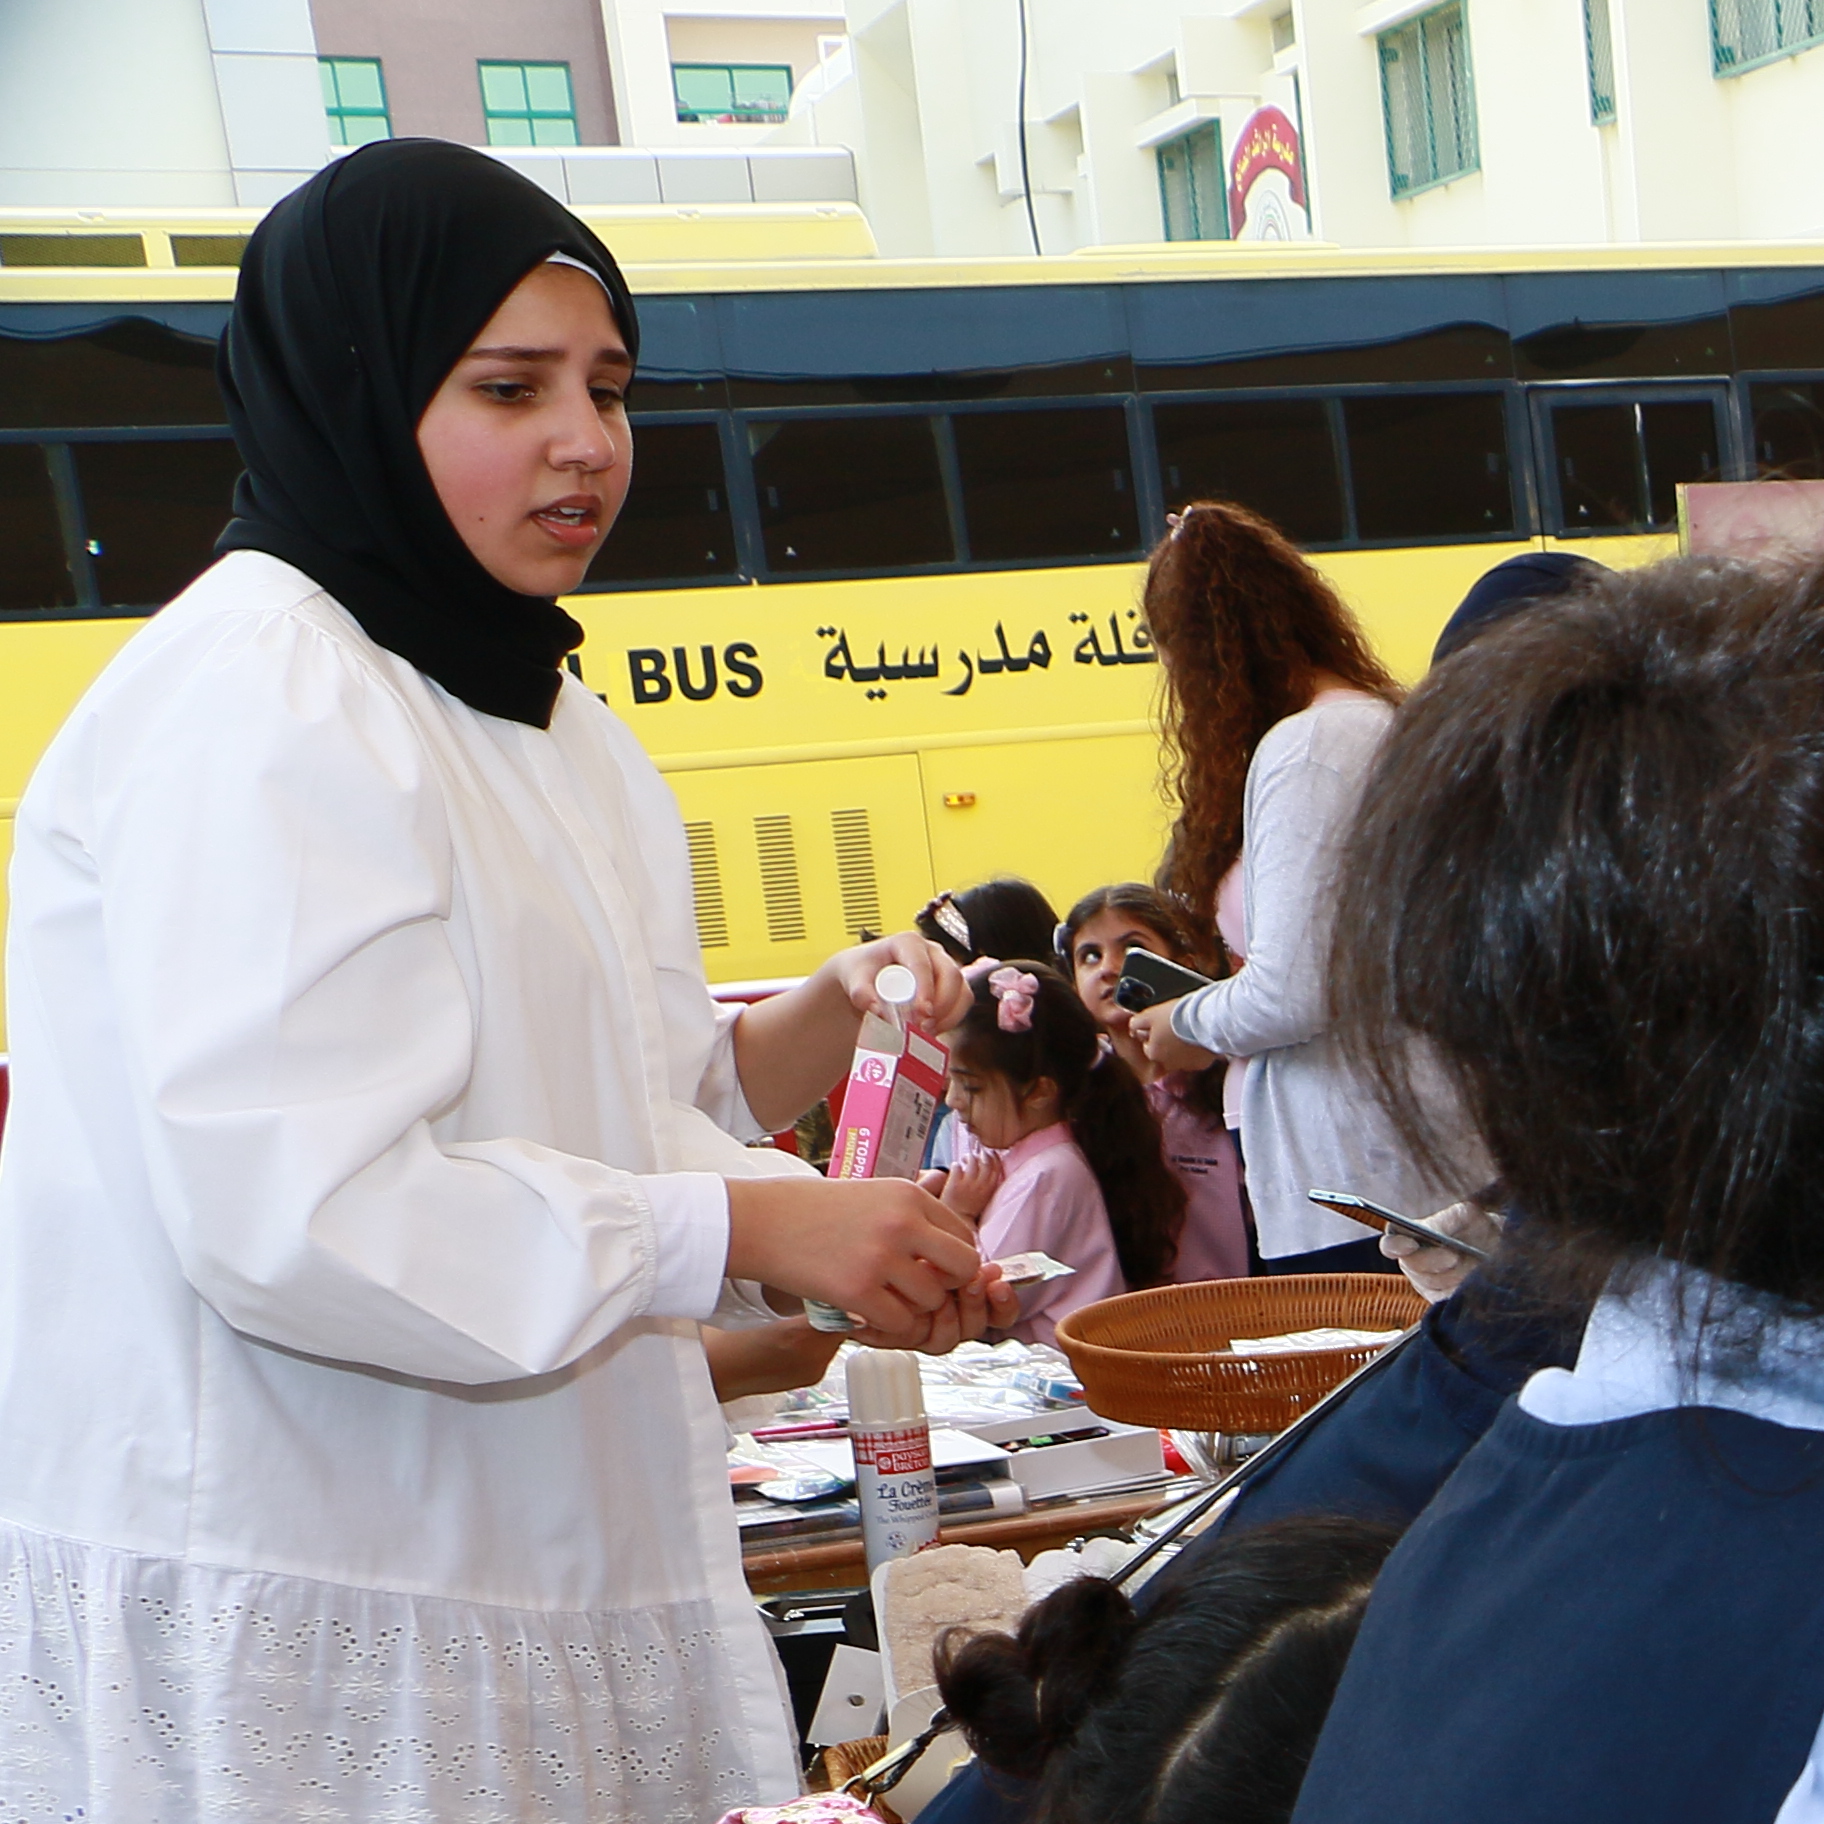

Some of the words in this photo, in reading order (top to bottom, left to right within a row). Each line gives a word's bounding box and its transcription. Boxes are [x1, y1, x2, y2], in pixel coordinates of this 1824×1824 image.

[816, 618, 1054, 700] مدرسية
[1067, 608, 1158, 666] فلة
[626, 641, 763, 704] BUS
[858, 1127, 871, 1137] 6
[851, 1138, 870, 1180] TOPPI
[876, 1482, 897, 1499] La
